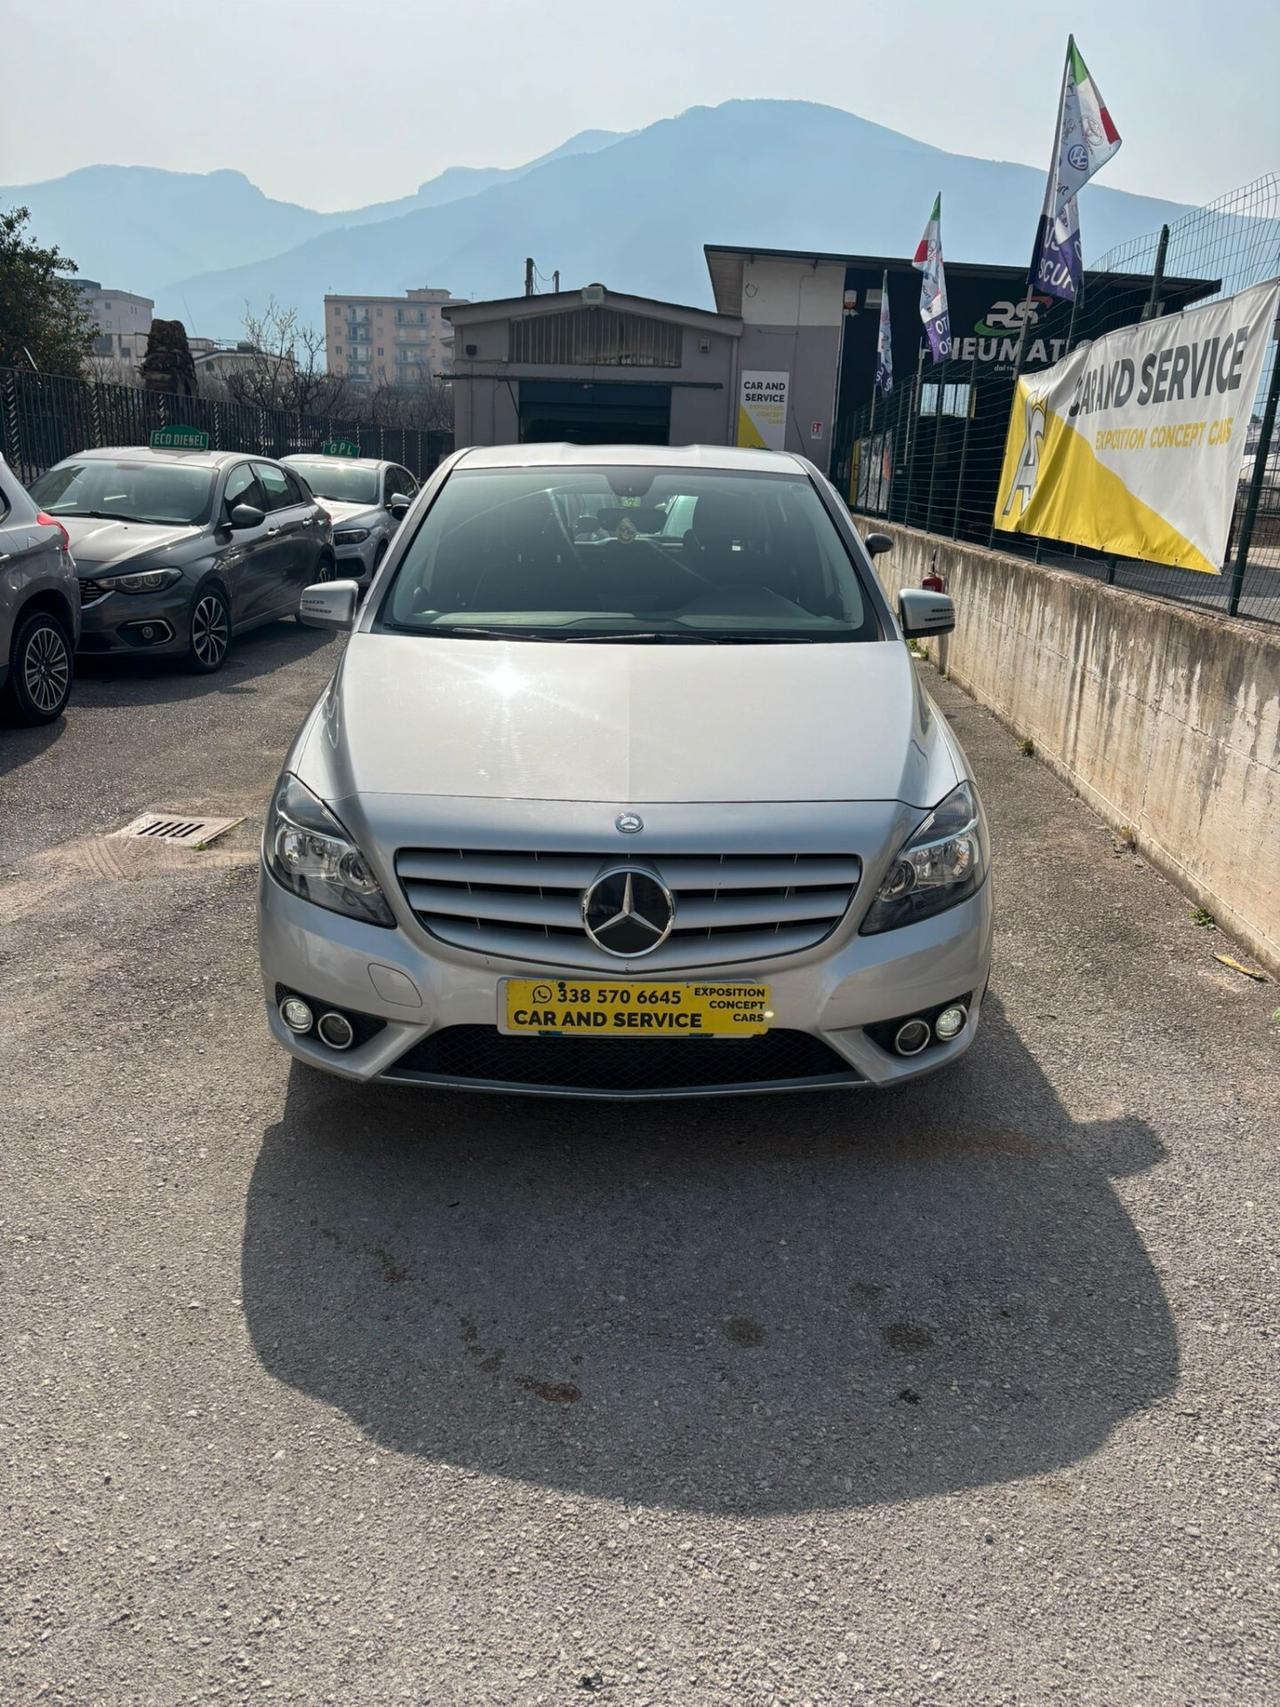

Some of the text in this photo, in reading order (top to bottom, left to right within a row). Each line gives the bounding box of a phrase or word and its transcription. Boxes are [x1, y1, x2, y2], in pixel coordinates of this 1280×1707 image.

[1097, 358, 1135, 410] AND
[1137, 326, 1249, 406] SERVICE
[744, 381, 785, 391] CAR AND
[745, 393, 785, 402] SERVICE
[154, 433, 205, 447] ECO DIESEL
[1150, 421, 1207, 448] CONCEPT
[558, 988, 681, 1005] 338 570 6645
[694, 988, 765, 997] EXPOSITION
[709, 1000, 765, 1010] CONCEPT
[514, 1010, 702, 1028] CAR AND SERVICE
[733, 1013, 764, 1022] CARS
